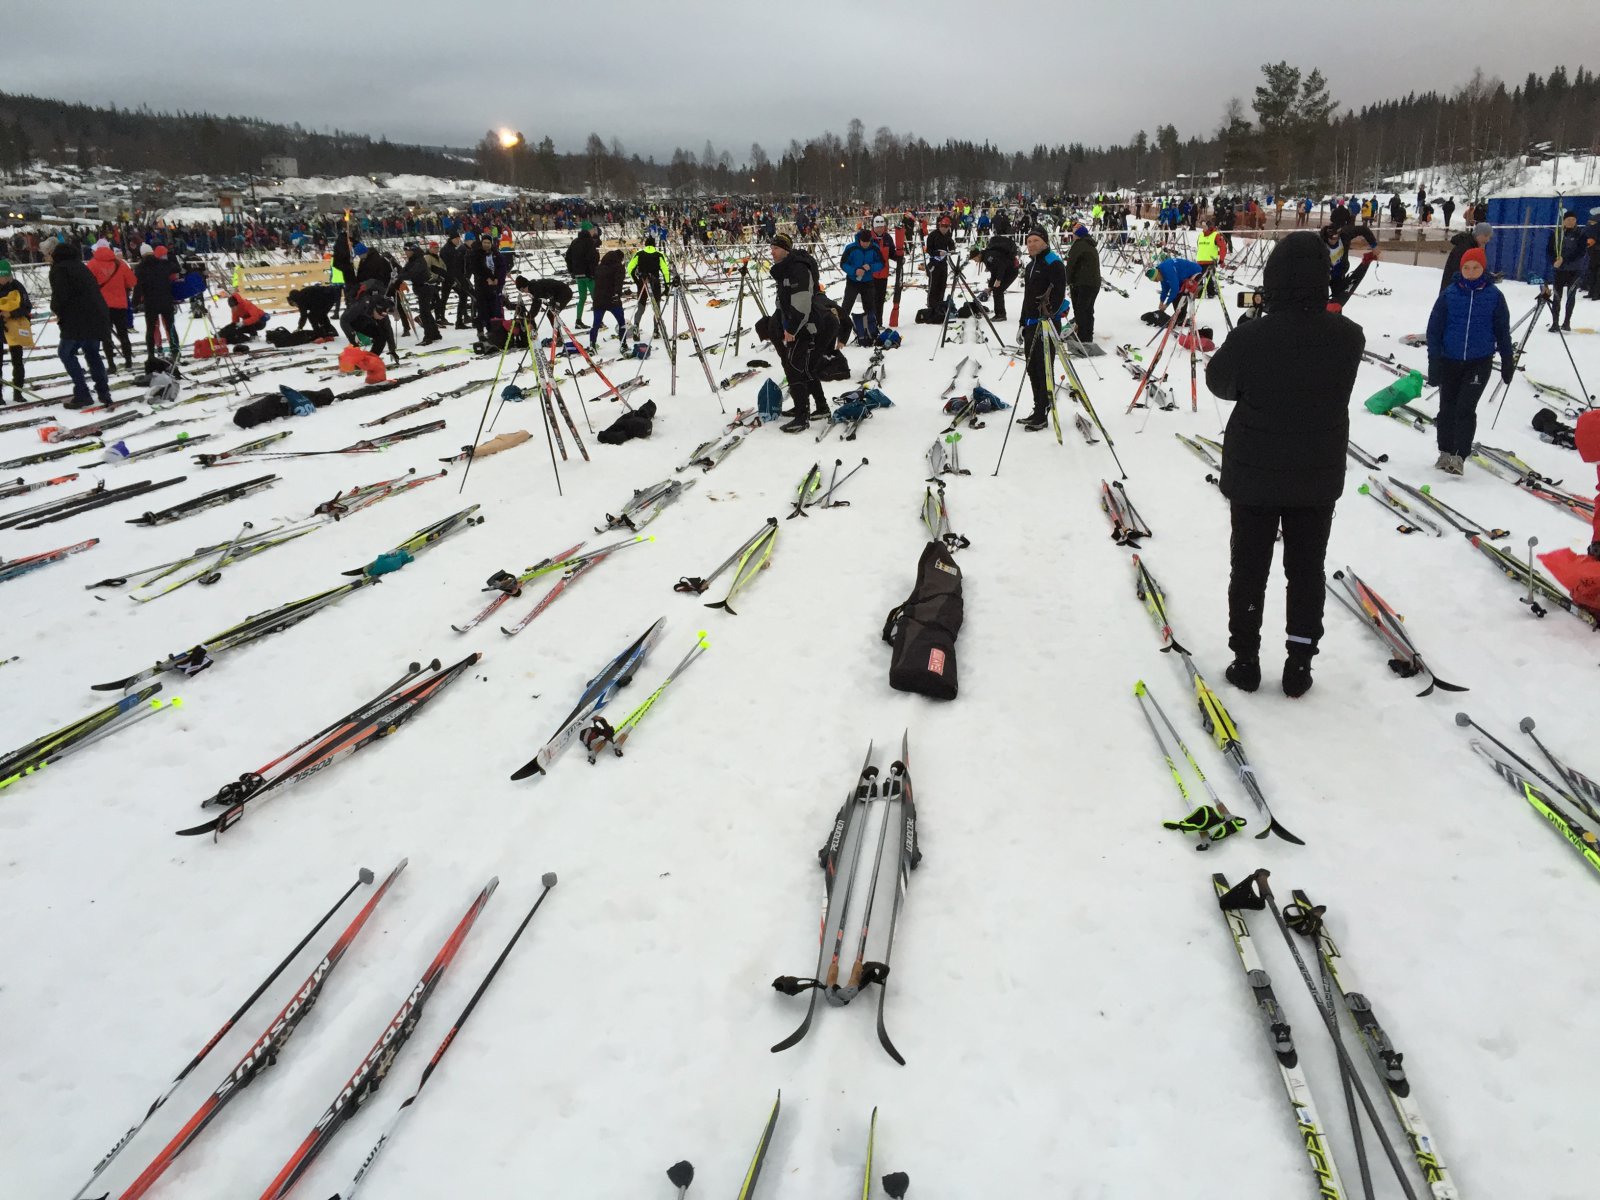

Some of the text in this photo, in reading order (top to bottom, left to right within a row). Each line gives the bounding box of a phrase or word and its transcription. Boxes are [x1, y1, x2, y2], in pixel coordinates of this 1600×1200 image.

[830, 819, 845, 852] PELTONEN
[215, 956, 331, 1099] MADSHUS
[315, 981, 425, 1132] MADSHUS
